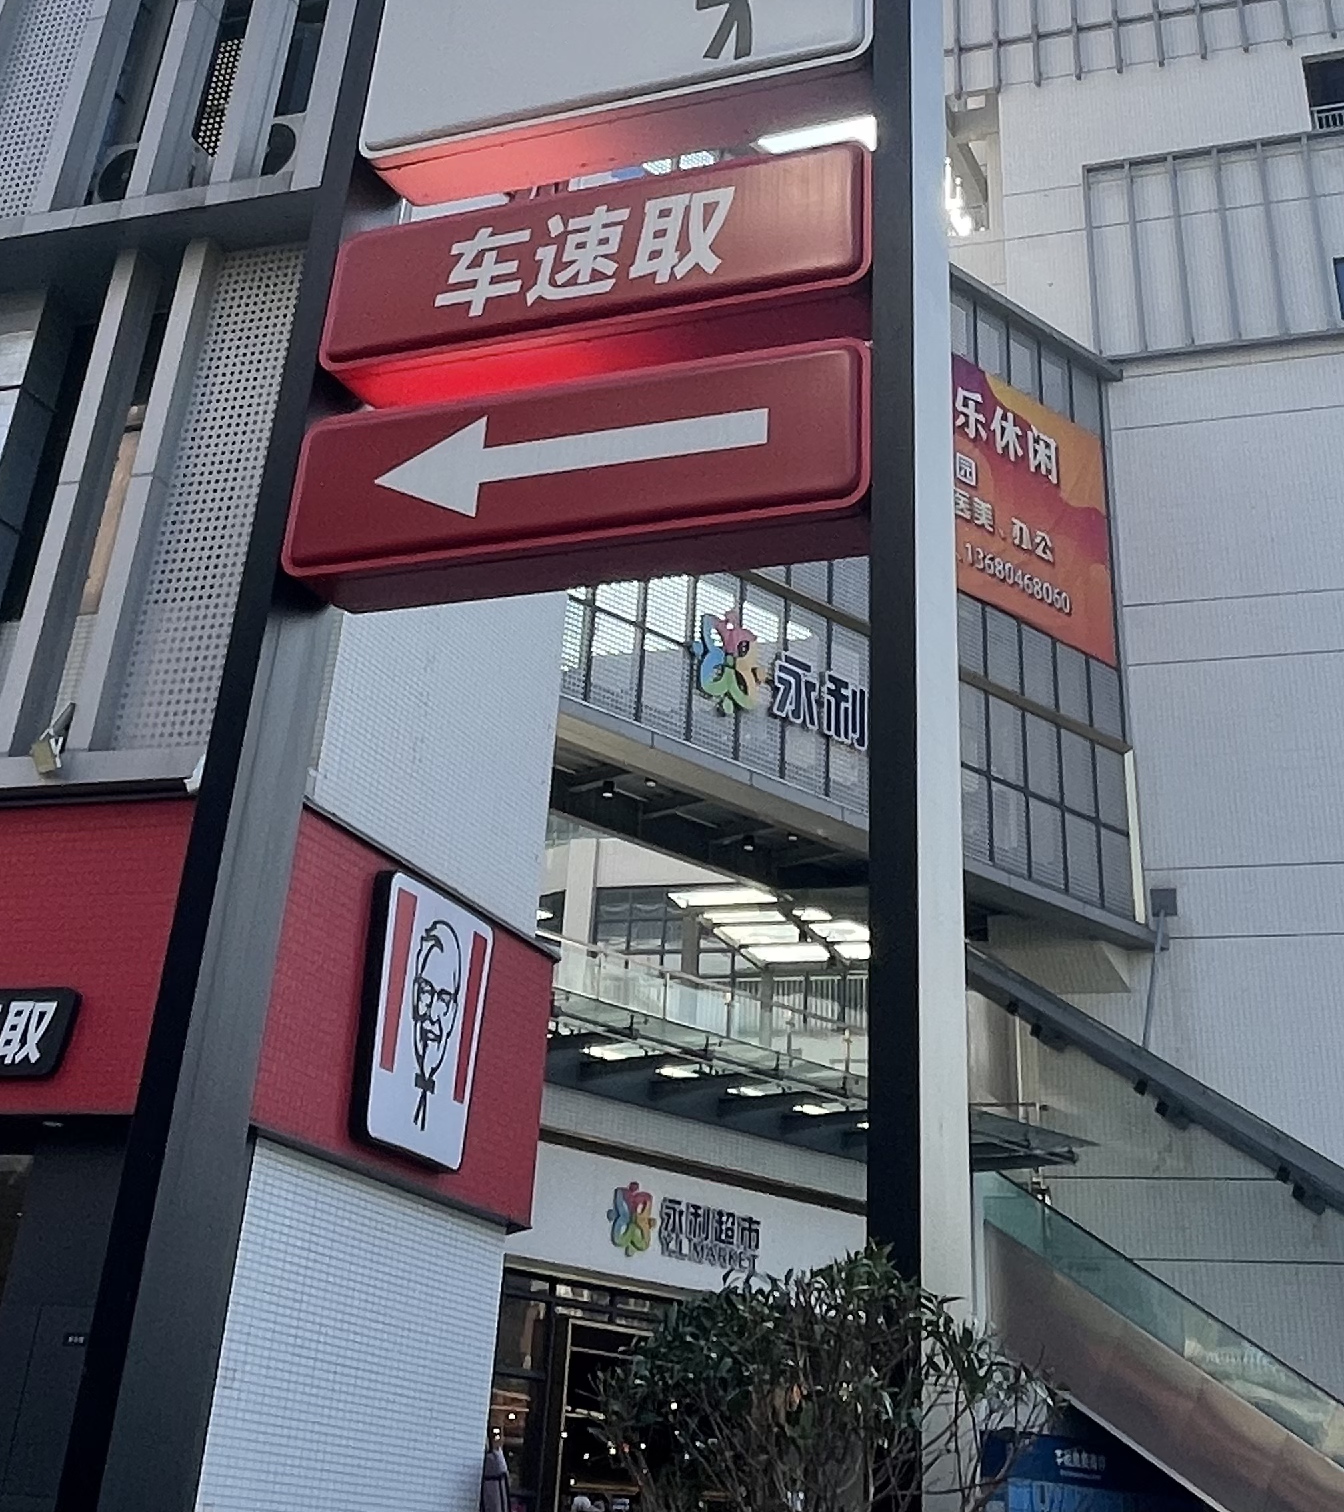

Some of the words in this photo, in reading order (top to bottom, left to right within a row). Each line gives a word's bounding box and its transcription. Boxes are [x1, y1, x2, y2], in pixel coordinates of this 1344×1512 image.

[434, 186, 736, 317] 车速取
[955, 386, 1058, 485] 乐休闲
[773, 650, 868, 751] 永利
[659, 1196, 761, 1251] 永利超市
